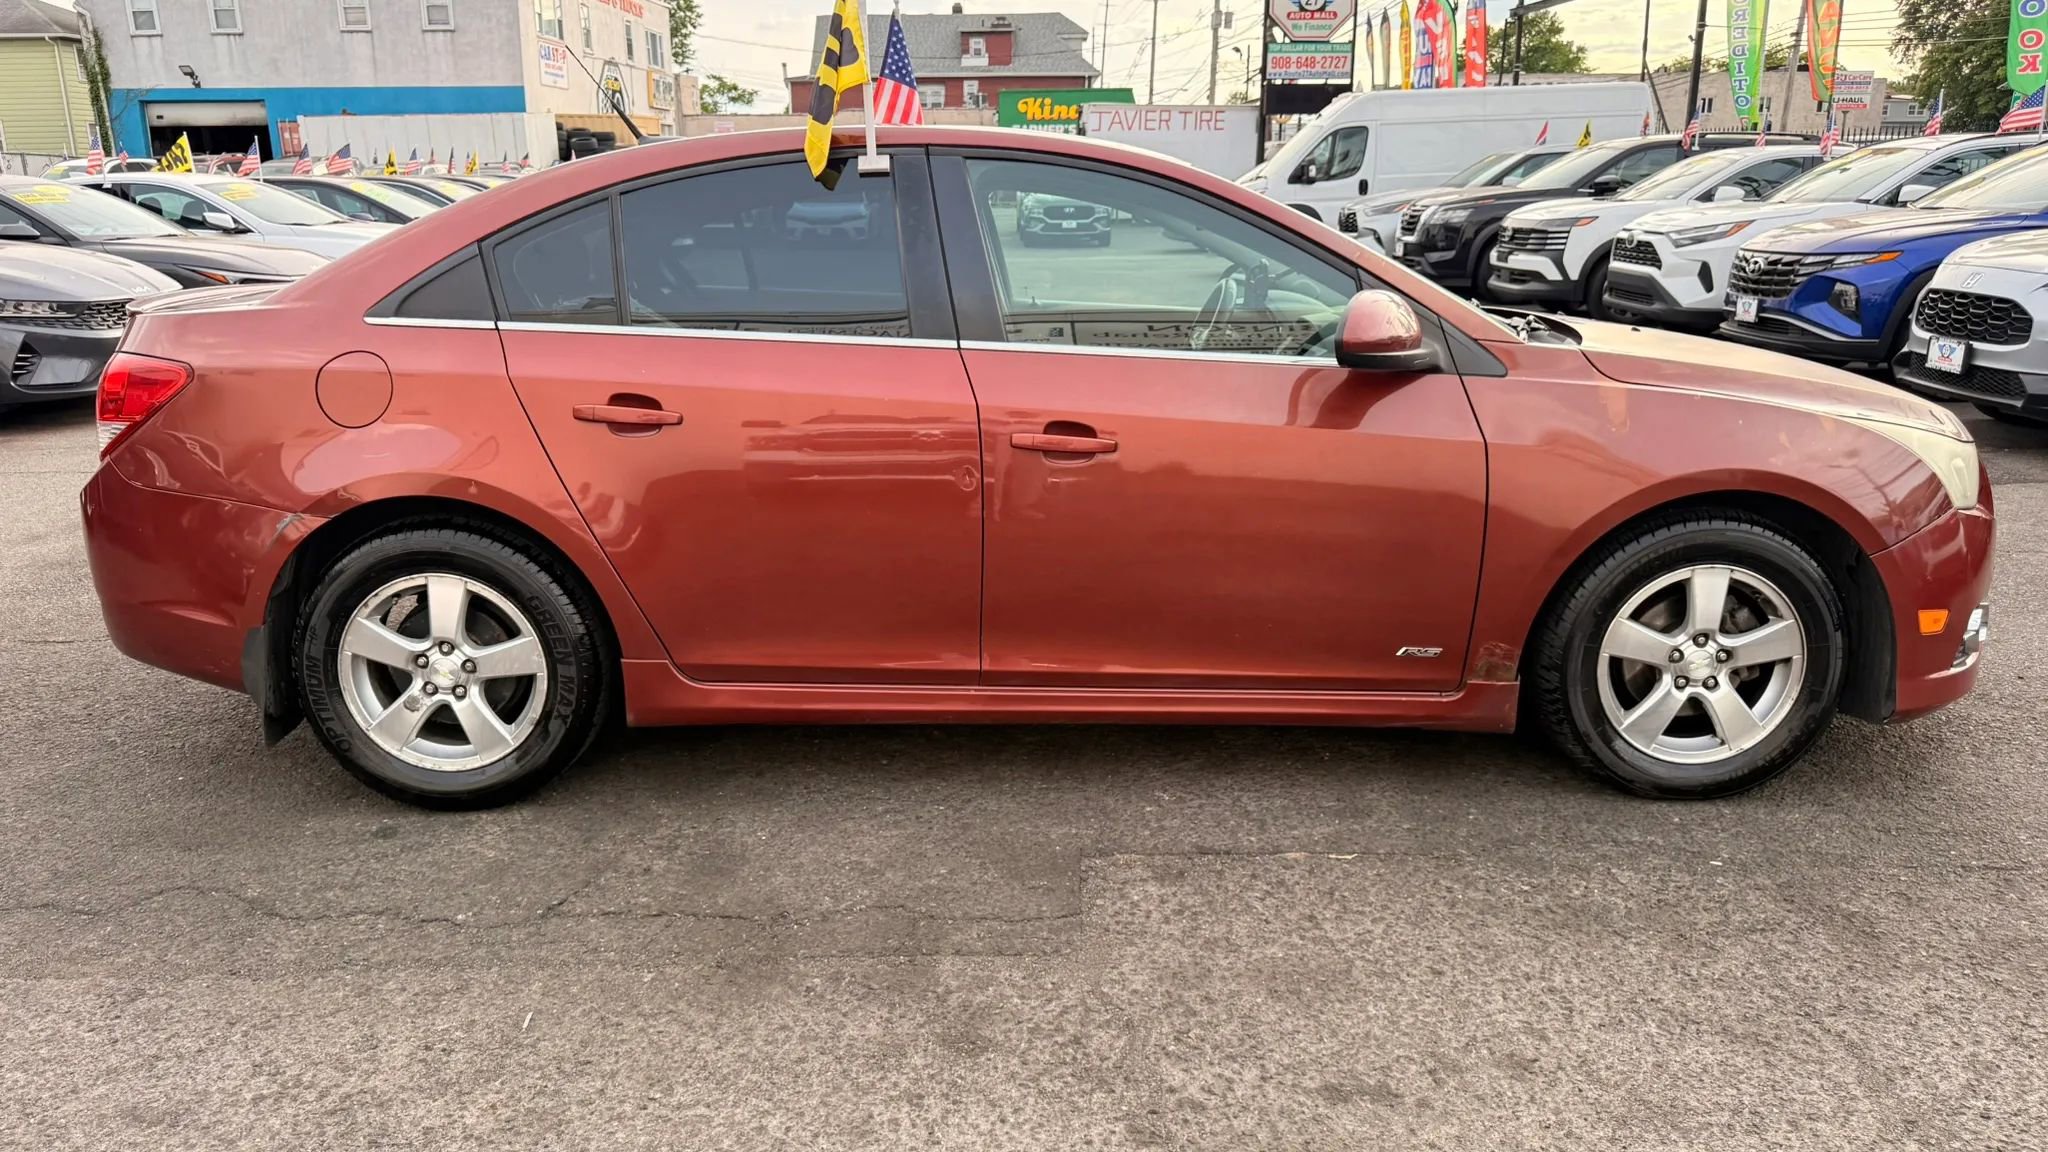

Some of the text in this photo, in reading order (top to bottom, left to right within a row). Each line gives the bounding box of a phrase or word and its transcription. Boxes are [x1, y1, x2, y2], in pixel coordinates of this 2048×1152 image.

[1291, 23, 1333, 31] We Finance
[1271, 55, 1348, 70] 908-648-2727
[1178, 110, 1226, 131] TIRE
[1396, 646, 1443, 657] RS
